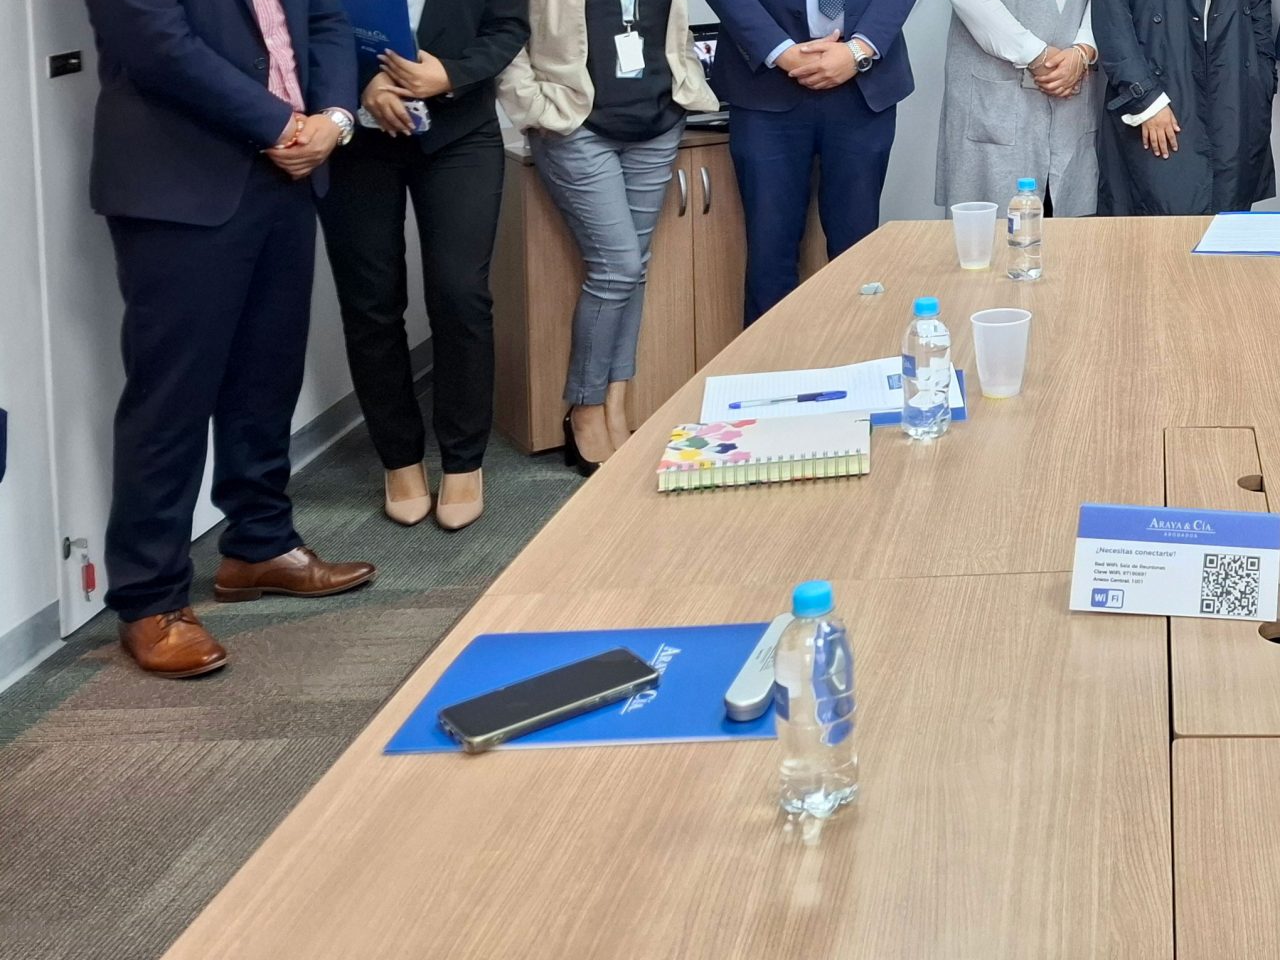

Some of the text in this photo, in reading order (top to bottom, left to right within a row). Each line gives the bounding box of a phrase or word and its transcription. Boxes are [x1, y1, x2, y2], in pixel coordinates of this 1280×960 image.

[1149, 517, 1182, 530] ARAYA
[1183, 521, 1191, 530] &
[1095, 547, 1176, 557] ¿Necesitas conectarte?
[1094, 593, 1119, 603] Wi Fi
